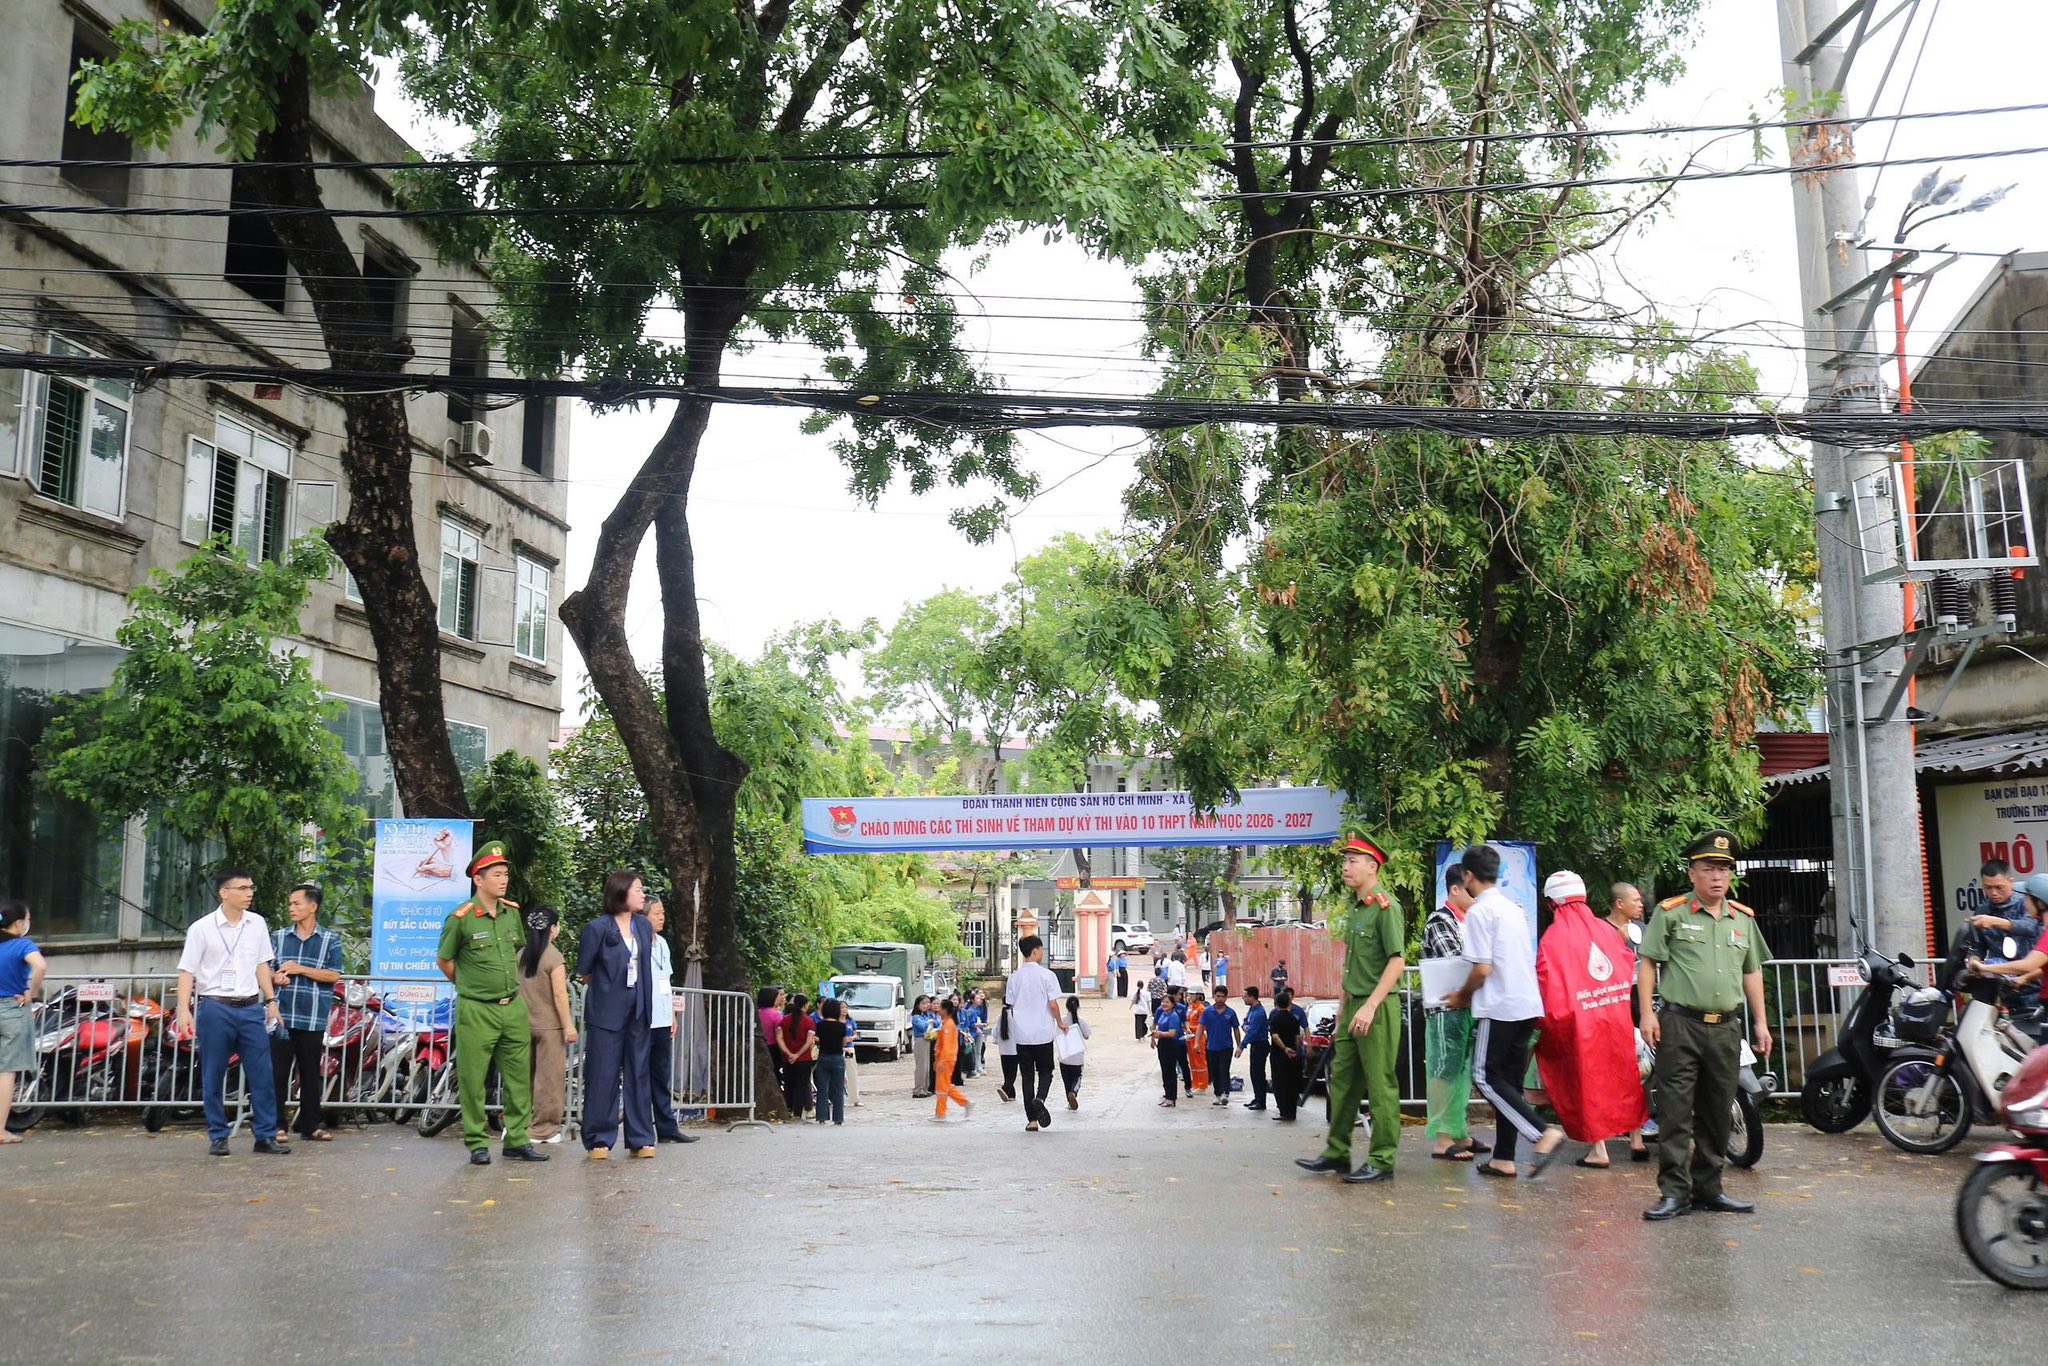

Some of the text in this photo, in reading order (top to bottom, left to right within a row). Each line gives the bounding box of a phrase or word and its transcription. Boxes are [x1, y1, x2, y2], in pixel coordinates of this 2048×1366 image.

[962, 797, 989, 809] ĐOÀN
[991, 798, 1022, 809] THANH
[1025, 796, 1048, 808] NIÊN
[1051, 795, 1077, 809] CỘNG
[1137, 795, 1163, 806] MINH
[1996, 803, 2030, 819] TRƯỜNG
[861, 818, 890, 836] CHÀO
[894, 817, 926, 835] MỪNG
[930, 816, 952, 834] CÁC
[956, 816, 973, 834] THÍ
[976, 816, 1003, 833] SINH
[1024, 816, 1055, 832] THAM
[1059, 816, 1075, 834] DỰ
[1095, 815, 1112, 831] THI
[1116, 813, 1138, 830] VÀO
[1142, 815, 1155, 830] 10
[1158, 814, 1186, 830] THPT
[1220, 813, 1242, 831] HỌC
[1246, 813, 1274, 828] 2026
[1285, 812, 1313, 828] 2027
[383, 834, 426, 848] 2026
[1979, 833, 2034, 874] MÔ
[390, 961, 403, 971] TIN
